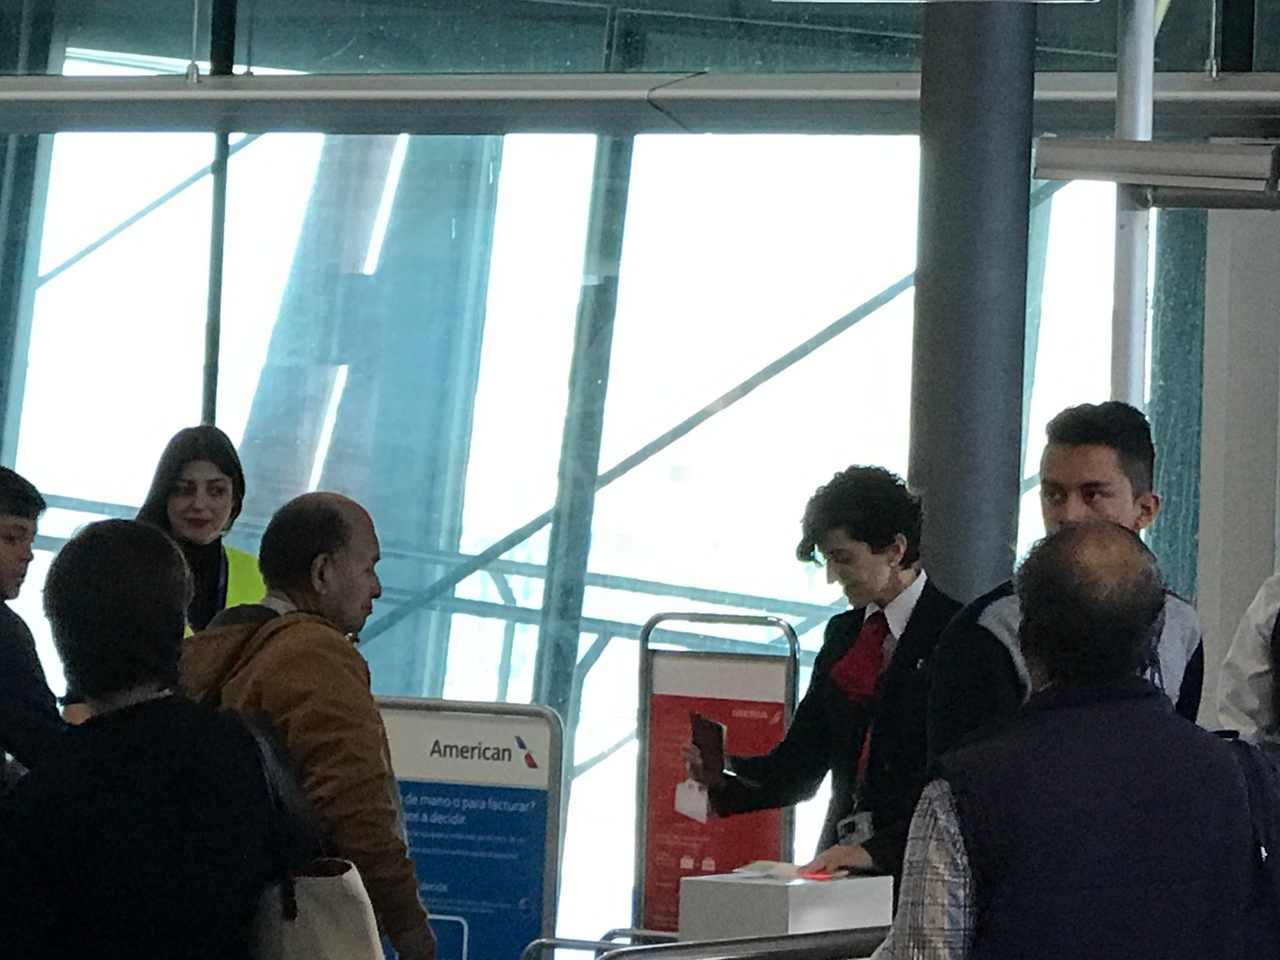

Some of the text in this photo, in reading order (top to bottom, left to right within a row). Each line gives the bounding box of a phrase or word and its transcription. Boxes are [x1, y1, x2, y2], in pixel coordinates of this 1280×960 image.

[430, 738, 512, 762] American
[420, 796, 451, 808] mano
[462, 797, 486, 812] para
